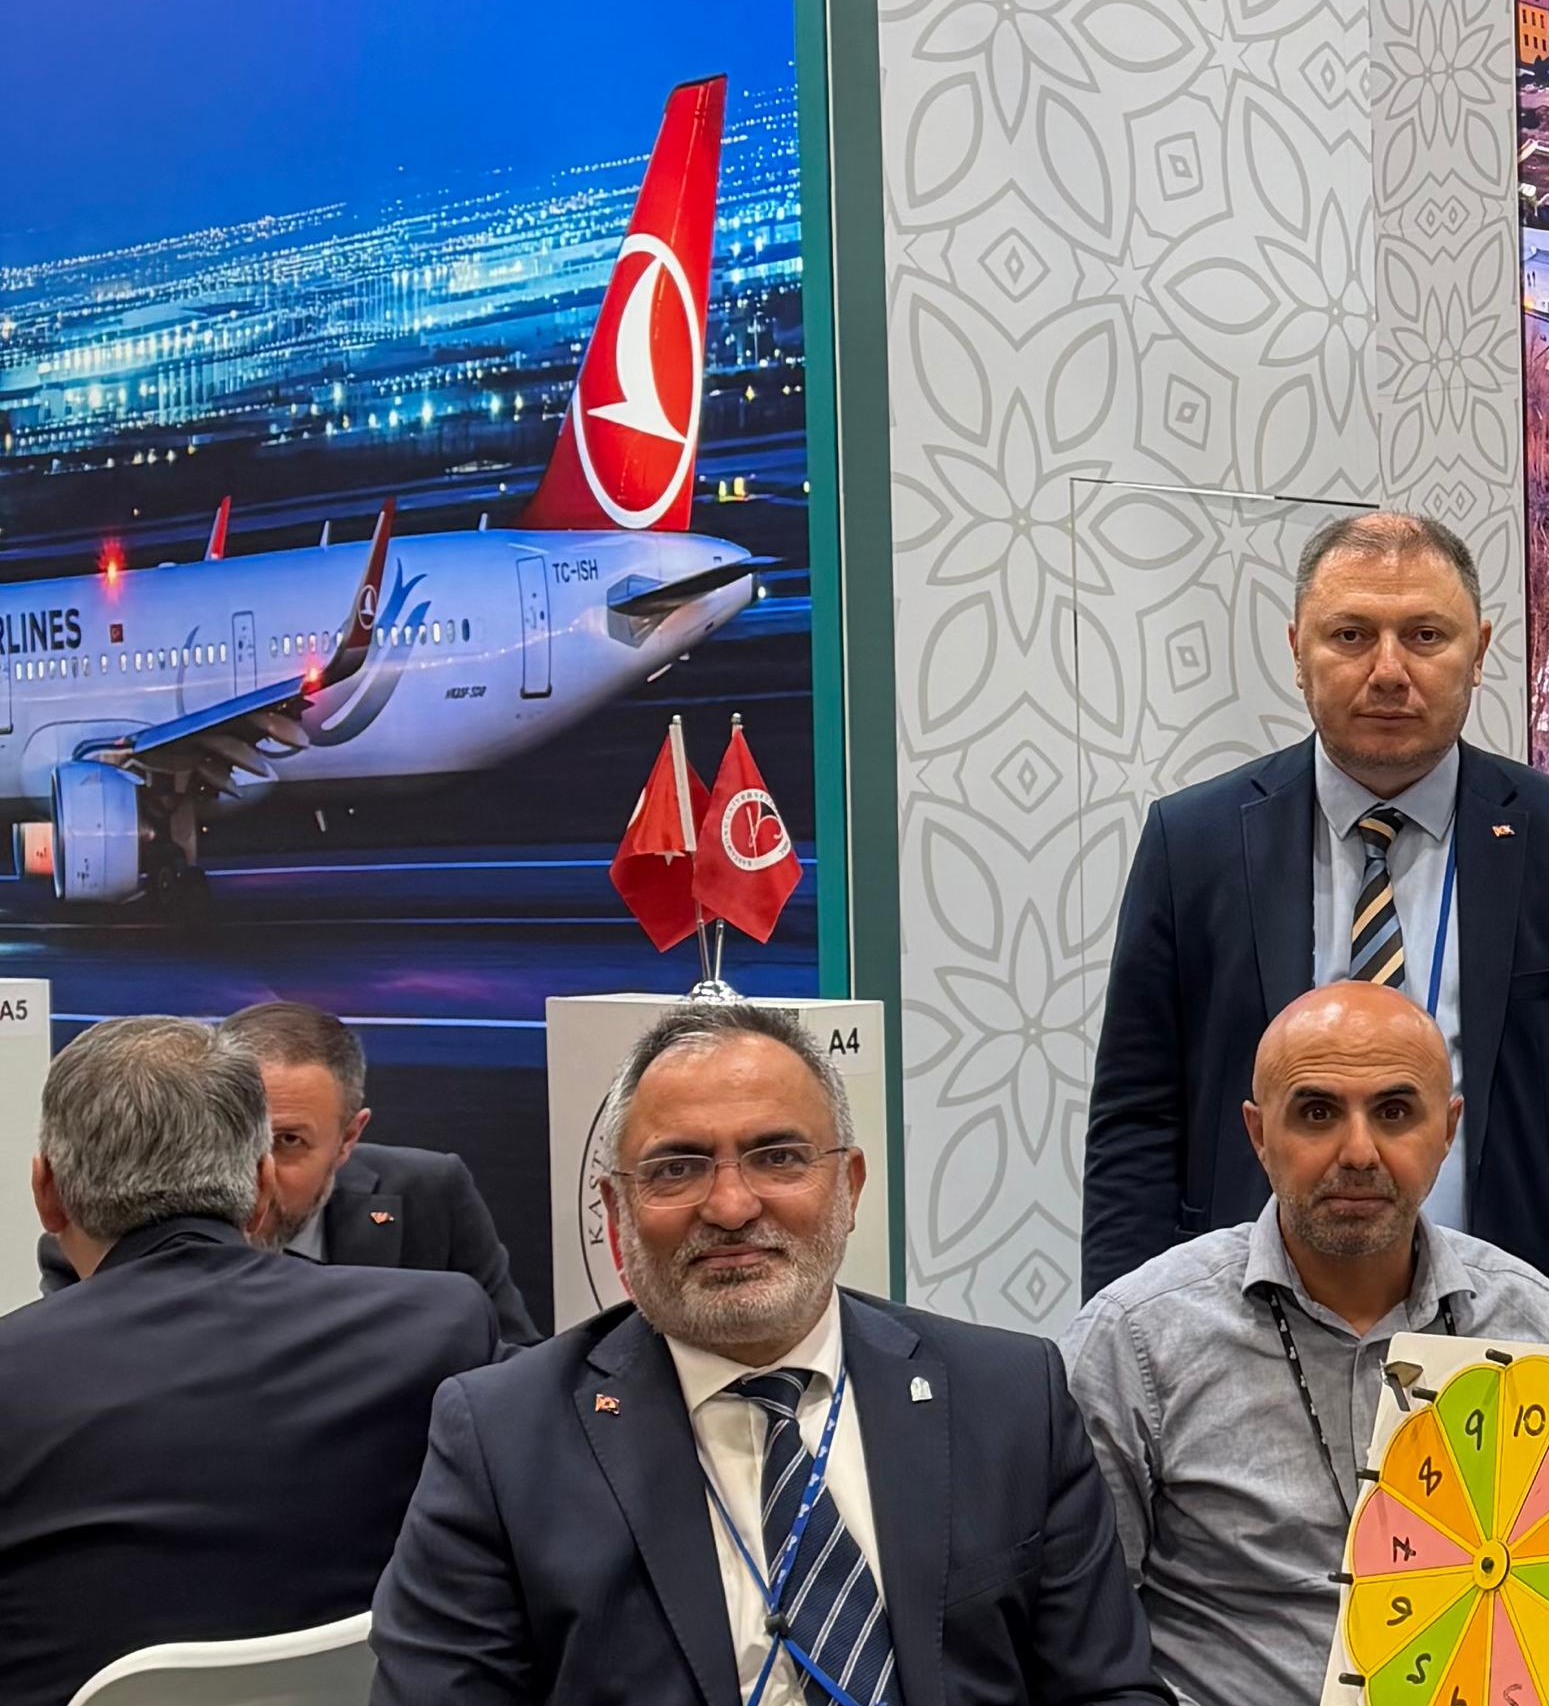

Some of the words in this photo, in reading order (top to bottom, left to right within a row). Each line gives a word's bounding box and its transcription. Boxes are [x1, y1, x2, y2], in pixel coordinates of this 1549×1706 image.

[552, 559, 598, 584] TC-ISH
[0, 999, 27, 1021] A5
[828, 1027, 861, 1056] A4
[588, 1135, 606, 1246] KAST
[1464, 1408, 1485, 1451] 9
[1513, 1403, 1546, 1437] 10
[1418, 1455, 1443, 1497] 8
